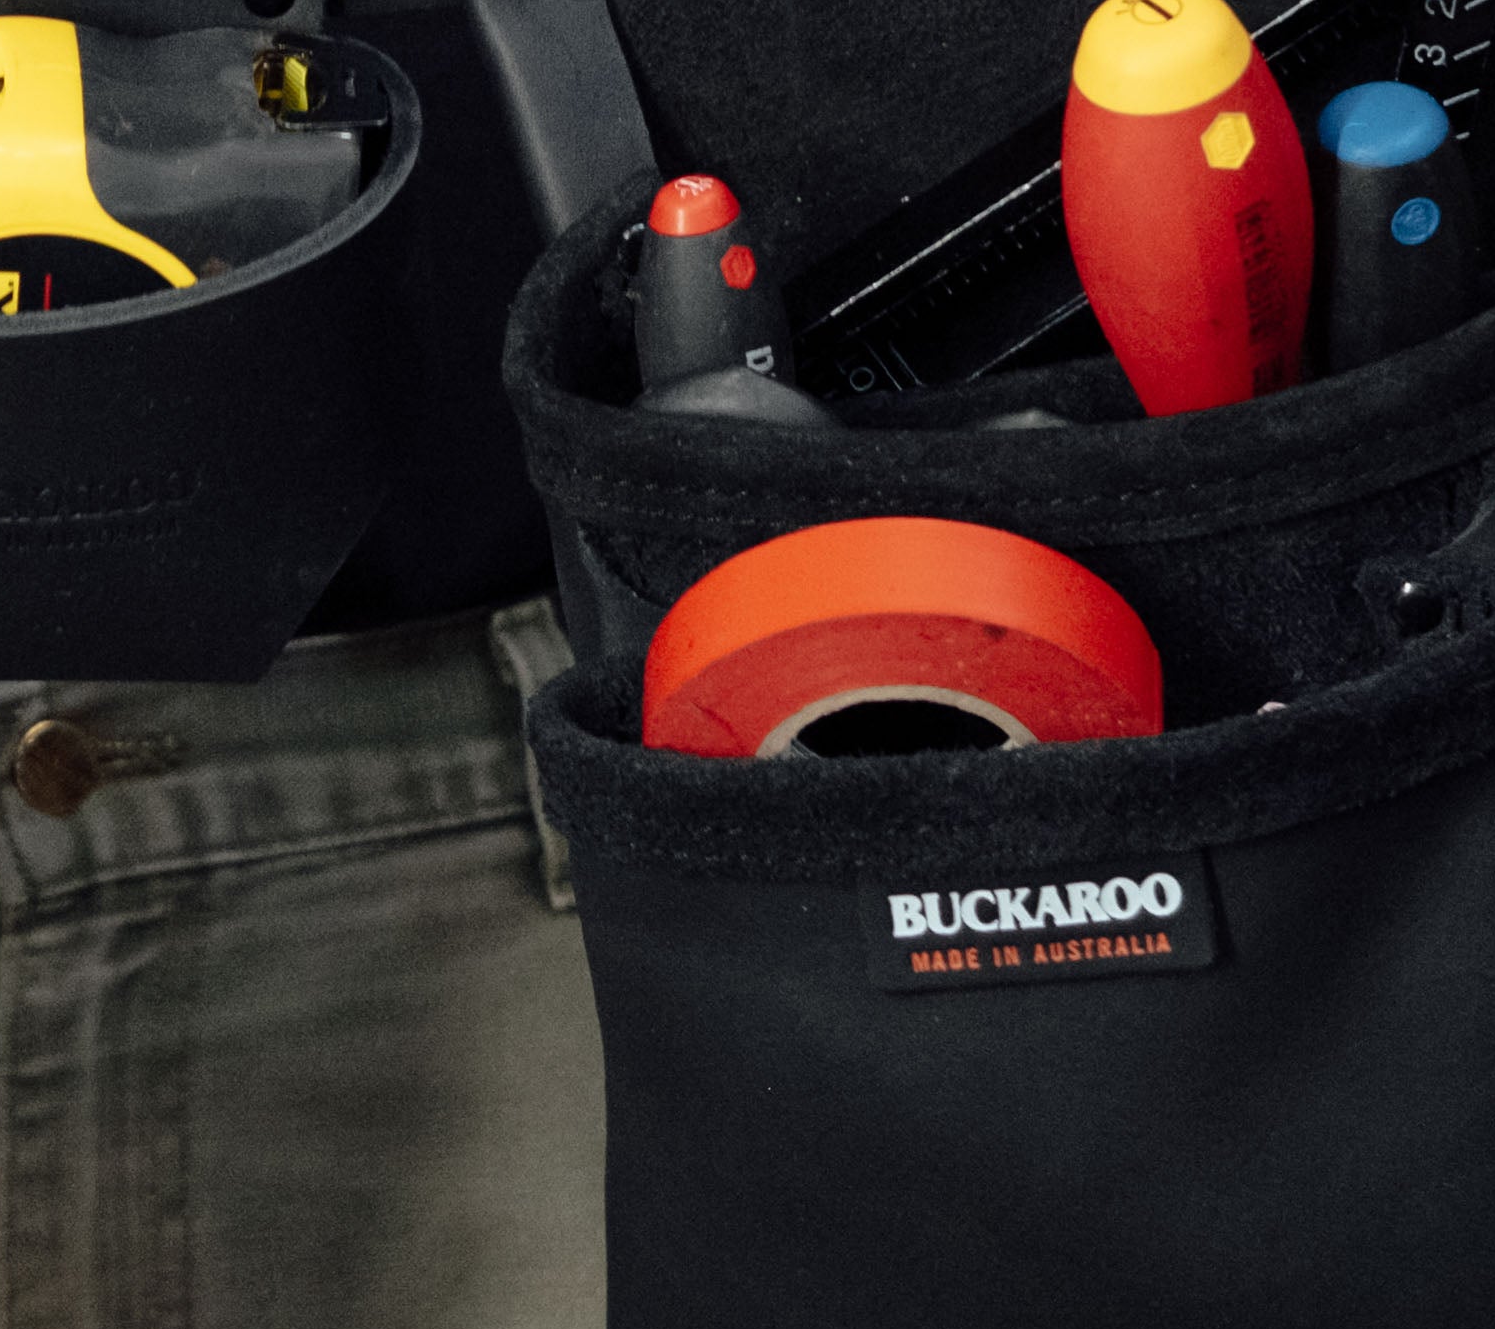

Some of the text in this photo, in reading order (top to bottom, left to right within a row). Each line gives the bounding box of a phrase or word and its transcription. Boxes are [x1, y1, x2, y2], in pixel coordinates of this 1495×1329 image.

[1414, 43, 1447, 66] 3
[887, 872, 1183, 938] BUCKAROO
[910, 933, 1172, 973] MADE IN AUSTRALIA
